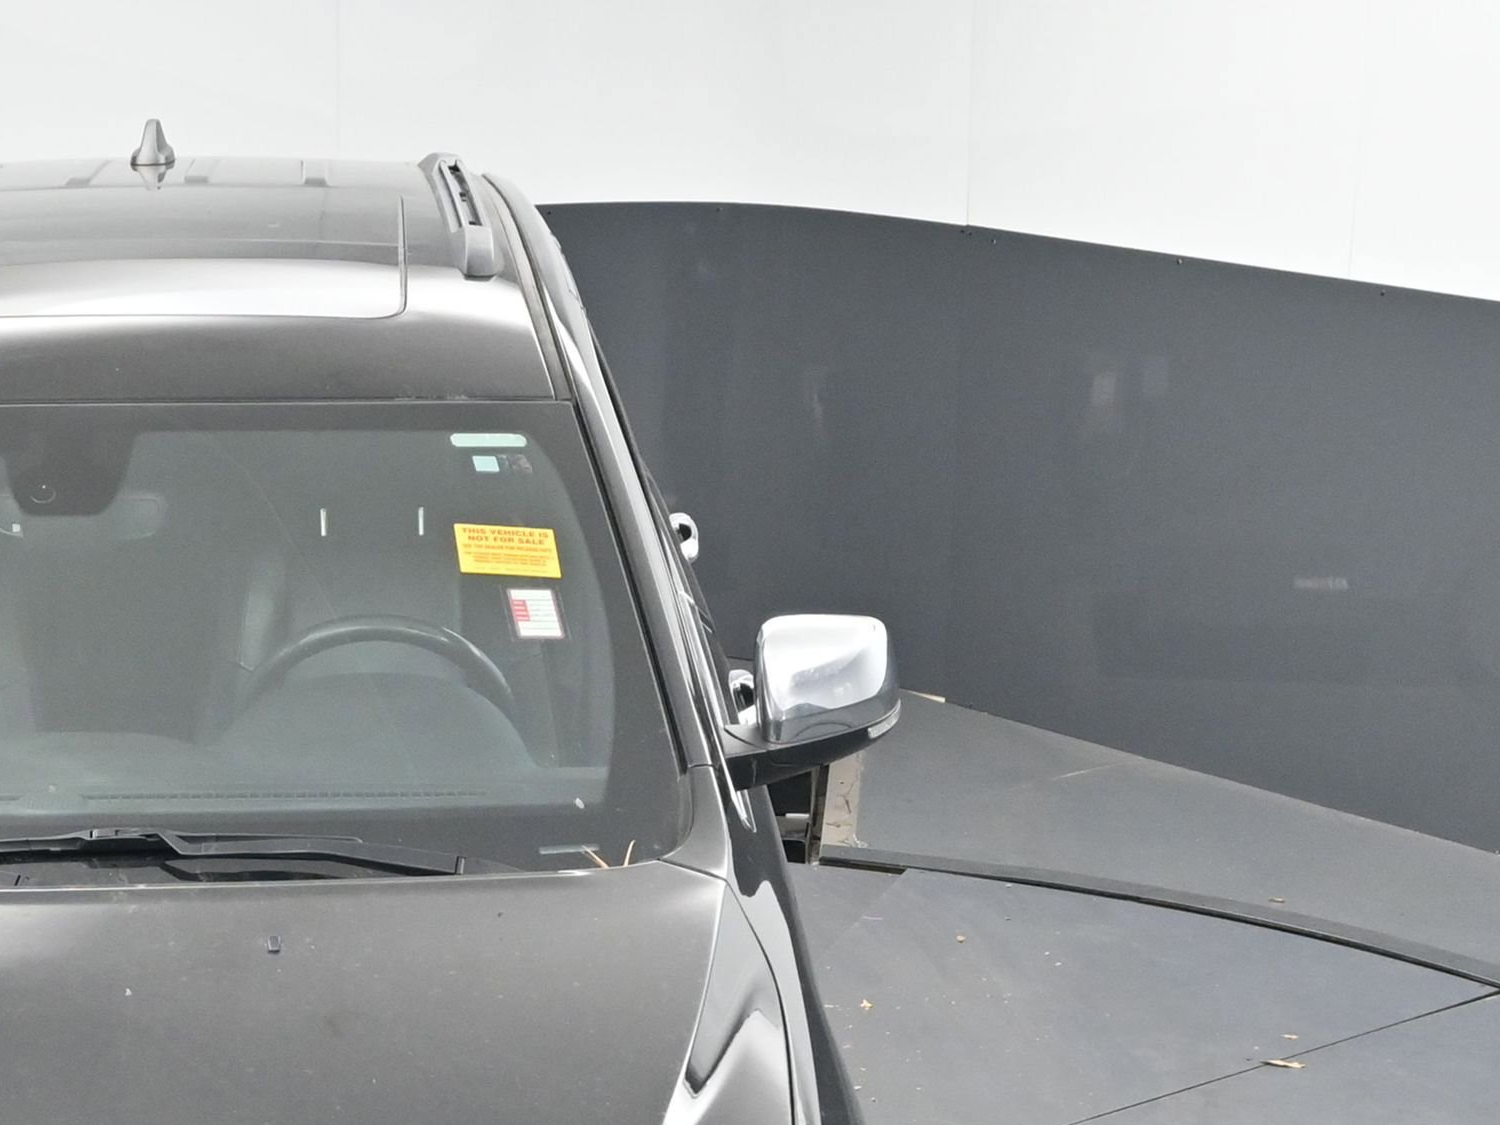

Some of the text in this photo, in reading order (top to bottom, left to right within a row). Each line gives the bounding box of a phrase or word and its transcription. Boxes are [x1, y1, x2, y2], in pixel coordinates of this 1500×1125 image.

[462, 527, 486, 535] THIS
[490, 529, 535, 537] VEHICLE
[518, 537, 544, 545] SALE
